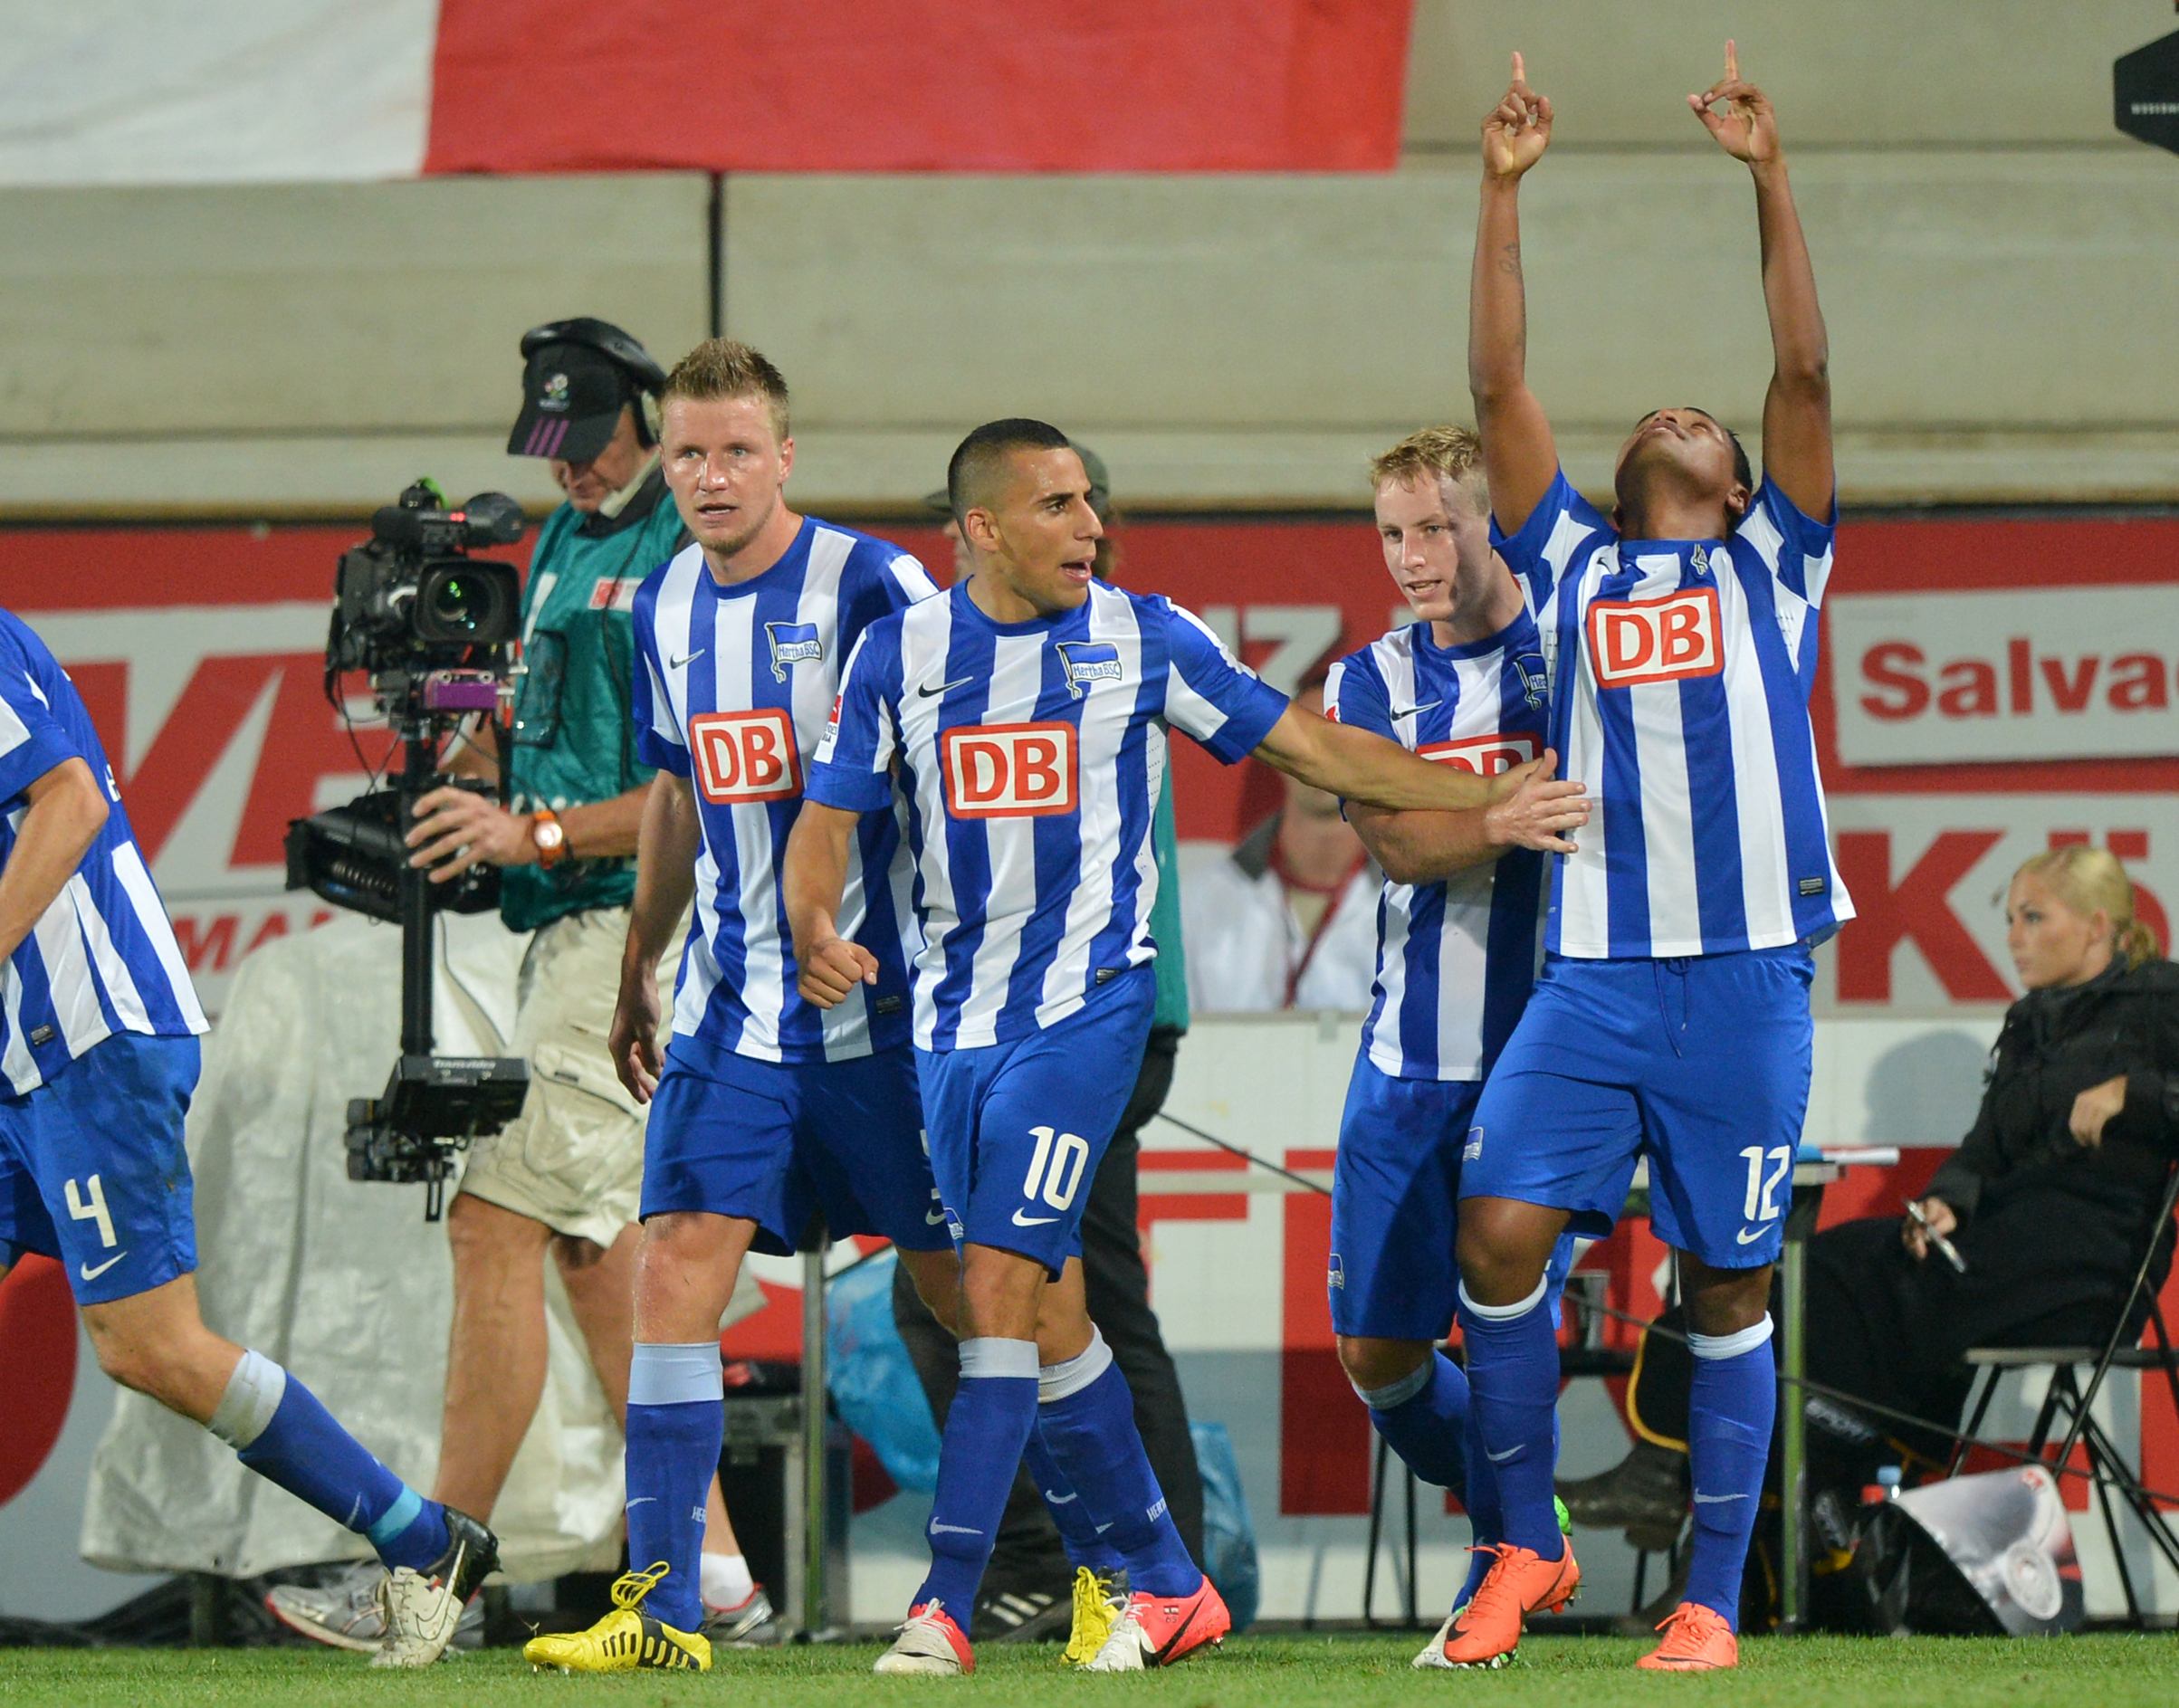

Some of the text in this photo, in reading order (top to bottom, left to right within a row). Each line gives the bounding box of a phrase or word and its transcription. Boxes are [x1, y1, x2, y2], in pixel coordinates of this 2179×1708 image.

[804, 643, 819, 655] BSC
[1074, 663, 1120, 678] Hertha BSC
[1606, 605, 1705, 672] DB
[1859, 636, 2179, 721] Salva
[702, 726, 783, 788] DB
[960, 738, 1060, 802] DB
[1023, 1125, 1089, 1211] 10
[1739, 1144, 1791, 1221] 12
[64, 1174, 117, 1247] 4
